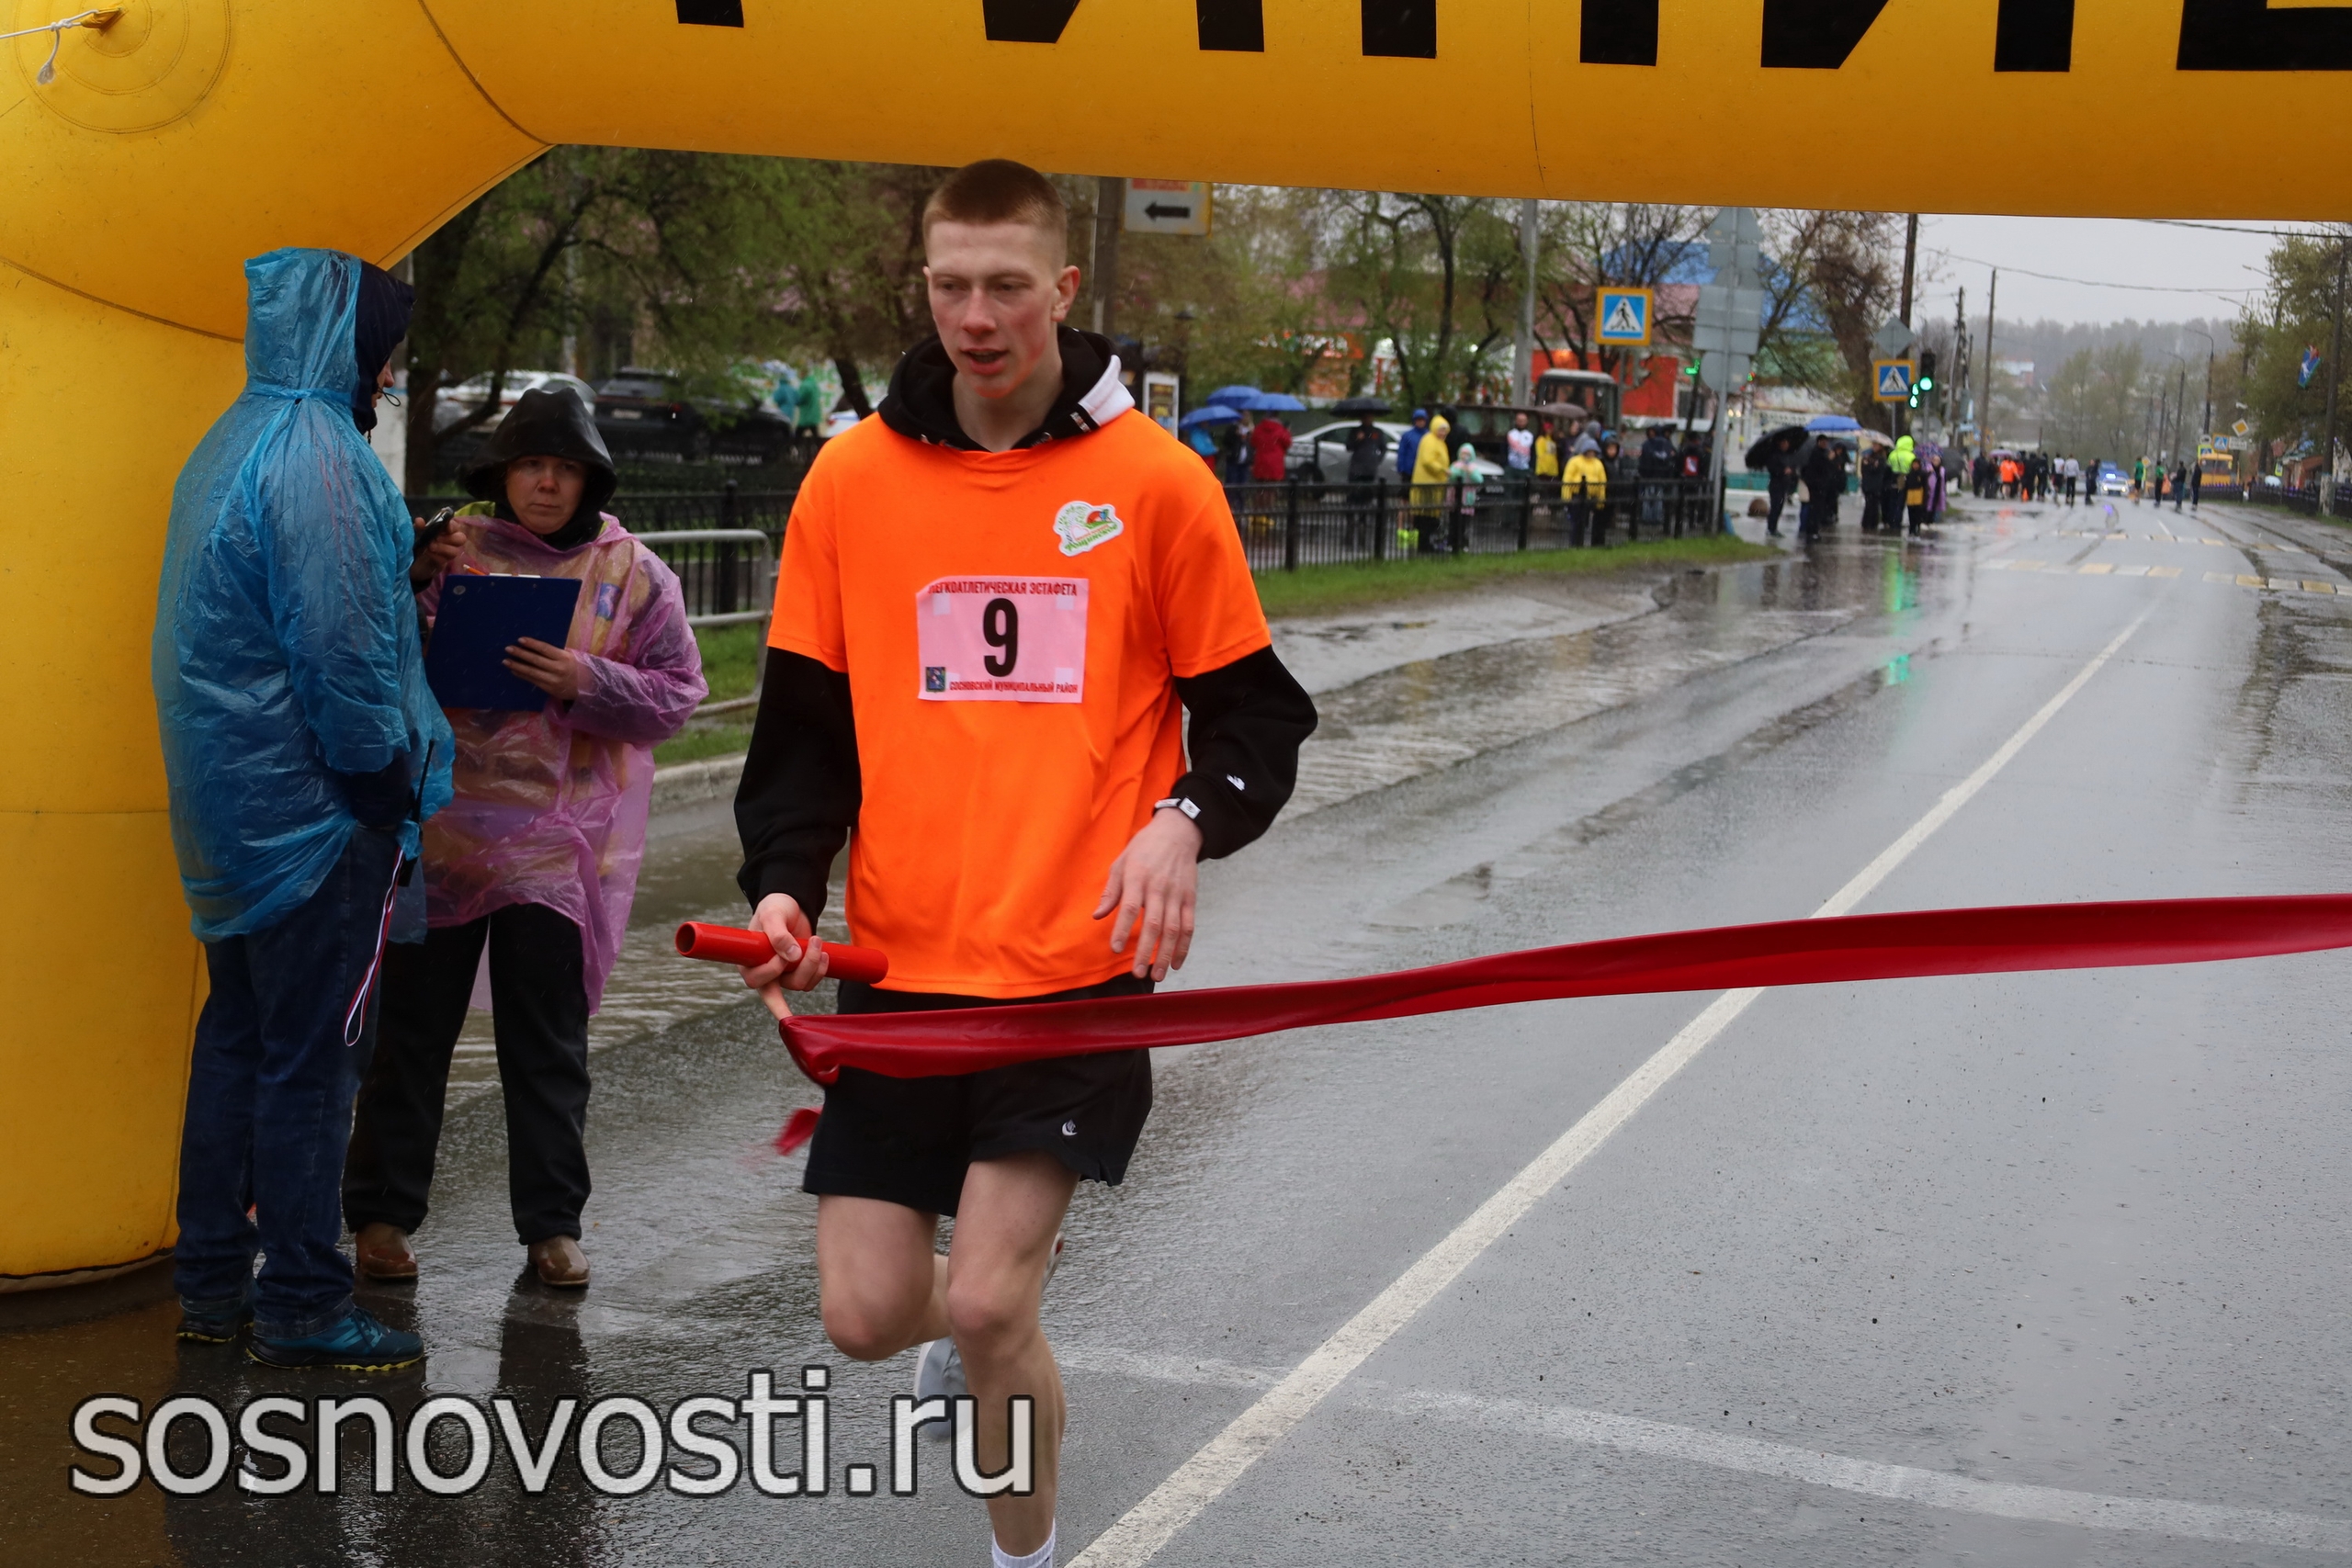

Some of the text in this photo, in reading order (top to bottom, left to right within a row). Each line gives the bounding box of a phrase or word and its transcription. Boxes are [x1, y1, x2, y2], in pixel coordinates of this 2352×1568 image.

[1029, 581, 1078, 596] ЭСТАФЕТА
[982, 597, 1019, 678] 9
[949, 680, 1079, 694] СОСНОВСКИЙ МУНИЦИПАЛЬНЫЙ РАЙОН
